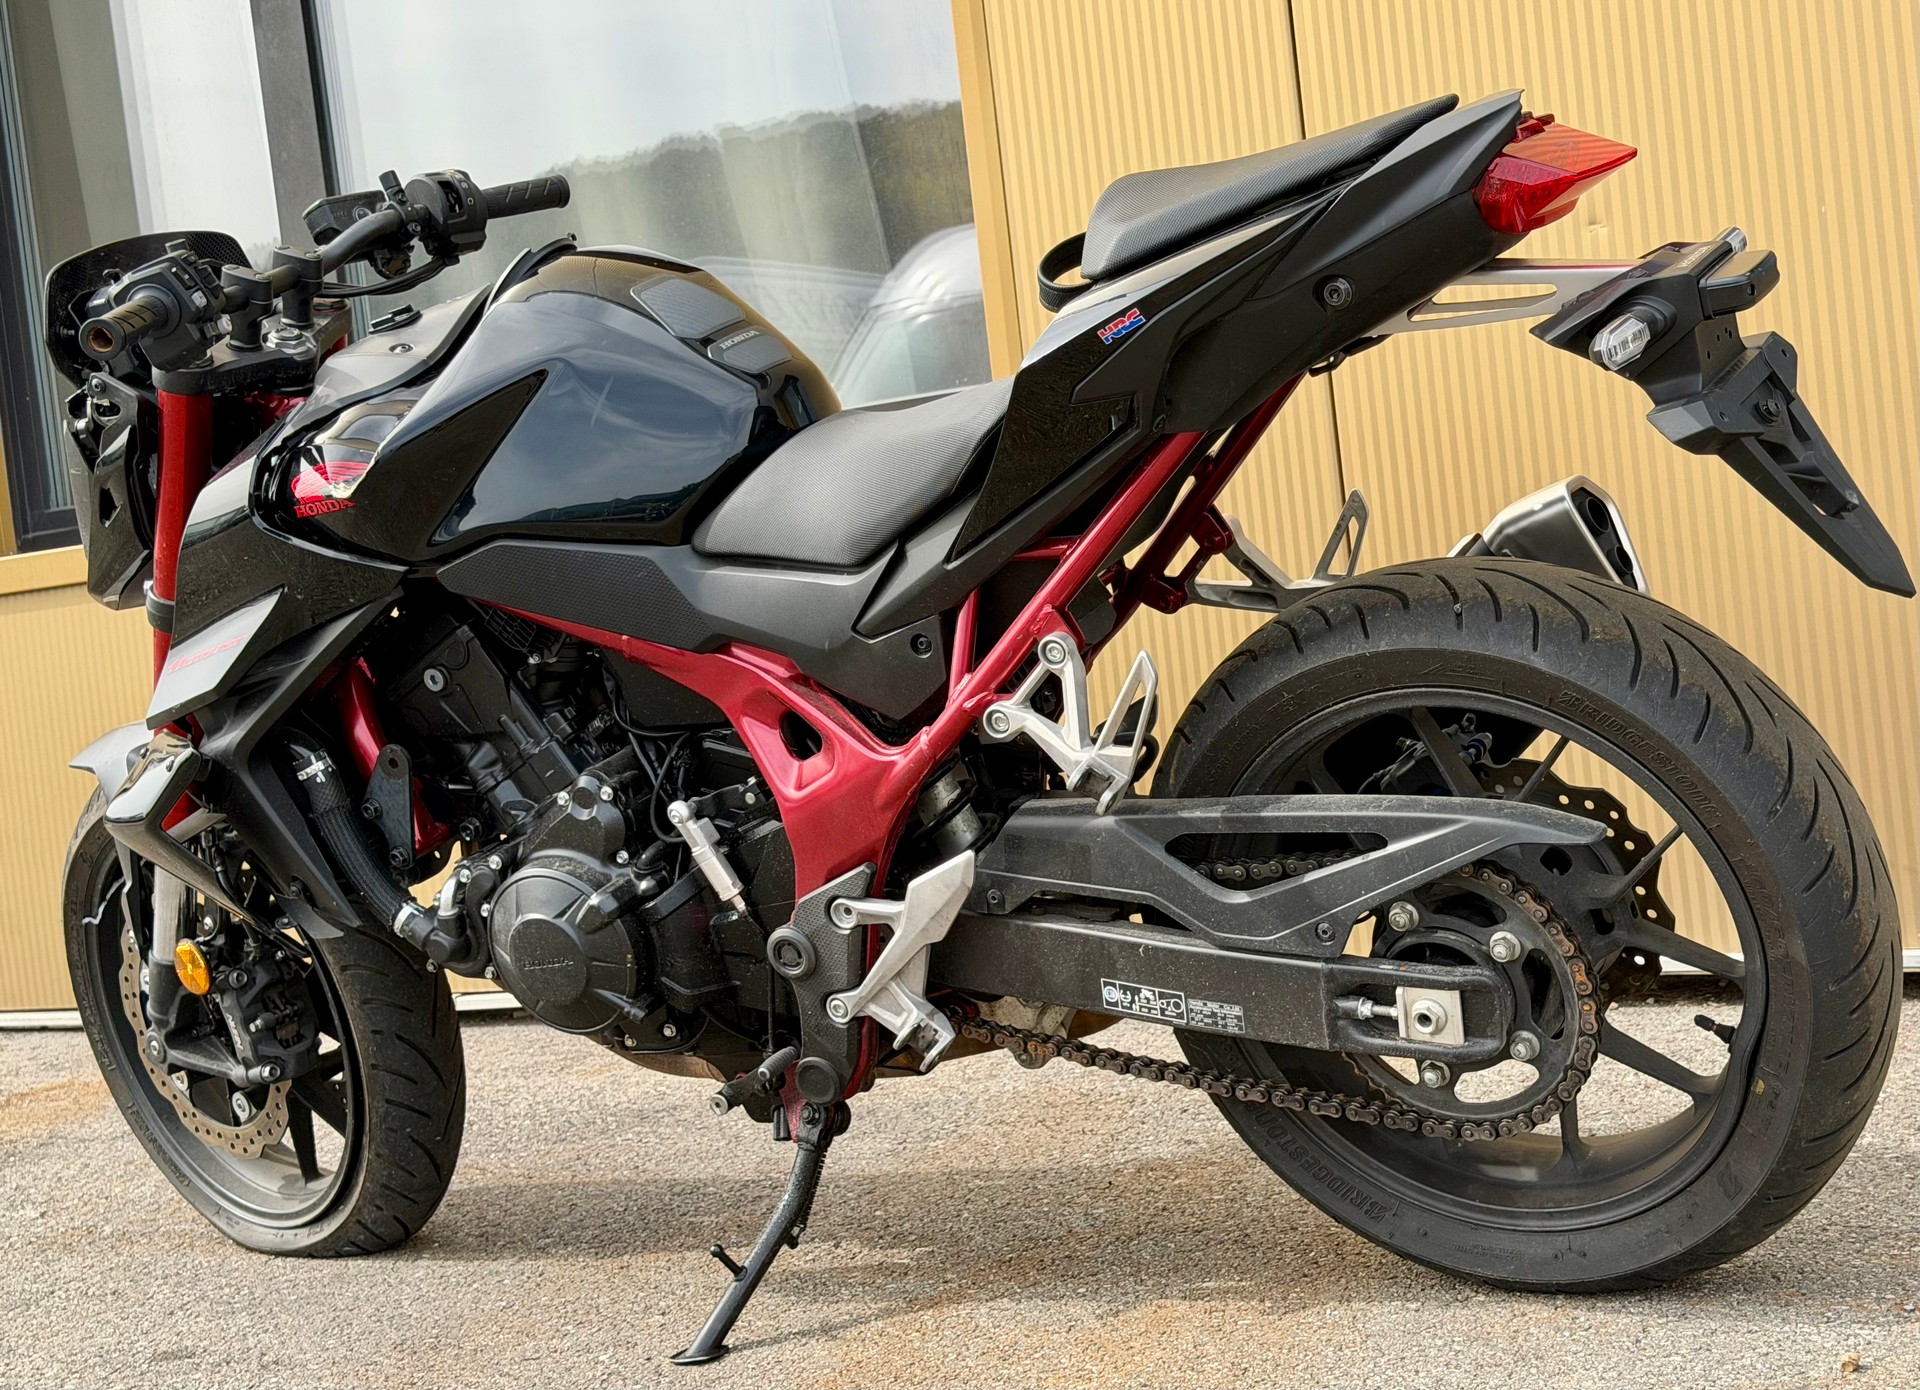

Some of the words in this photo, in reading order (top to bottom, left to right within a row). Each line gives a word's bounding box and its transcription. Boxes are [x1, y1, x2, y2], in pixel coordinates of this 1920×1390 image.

[719, 330, 760, 350] HONDA
[1097, 307, 1146, 345] HRC
[293, 498, 356, 518] HONDA
[1556, 689, 1723, 820] BRIDGESTONE
